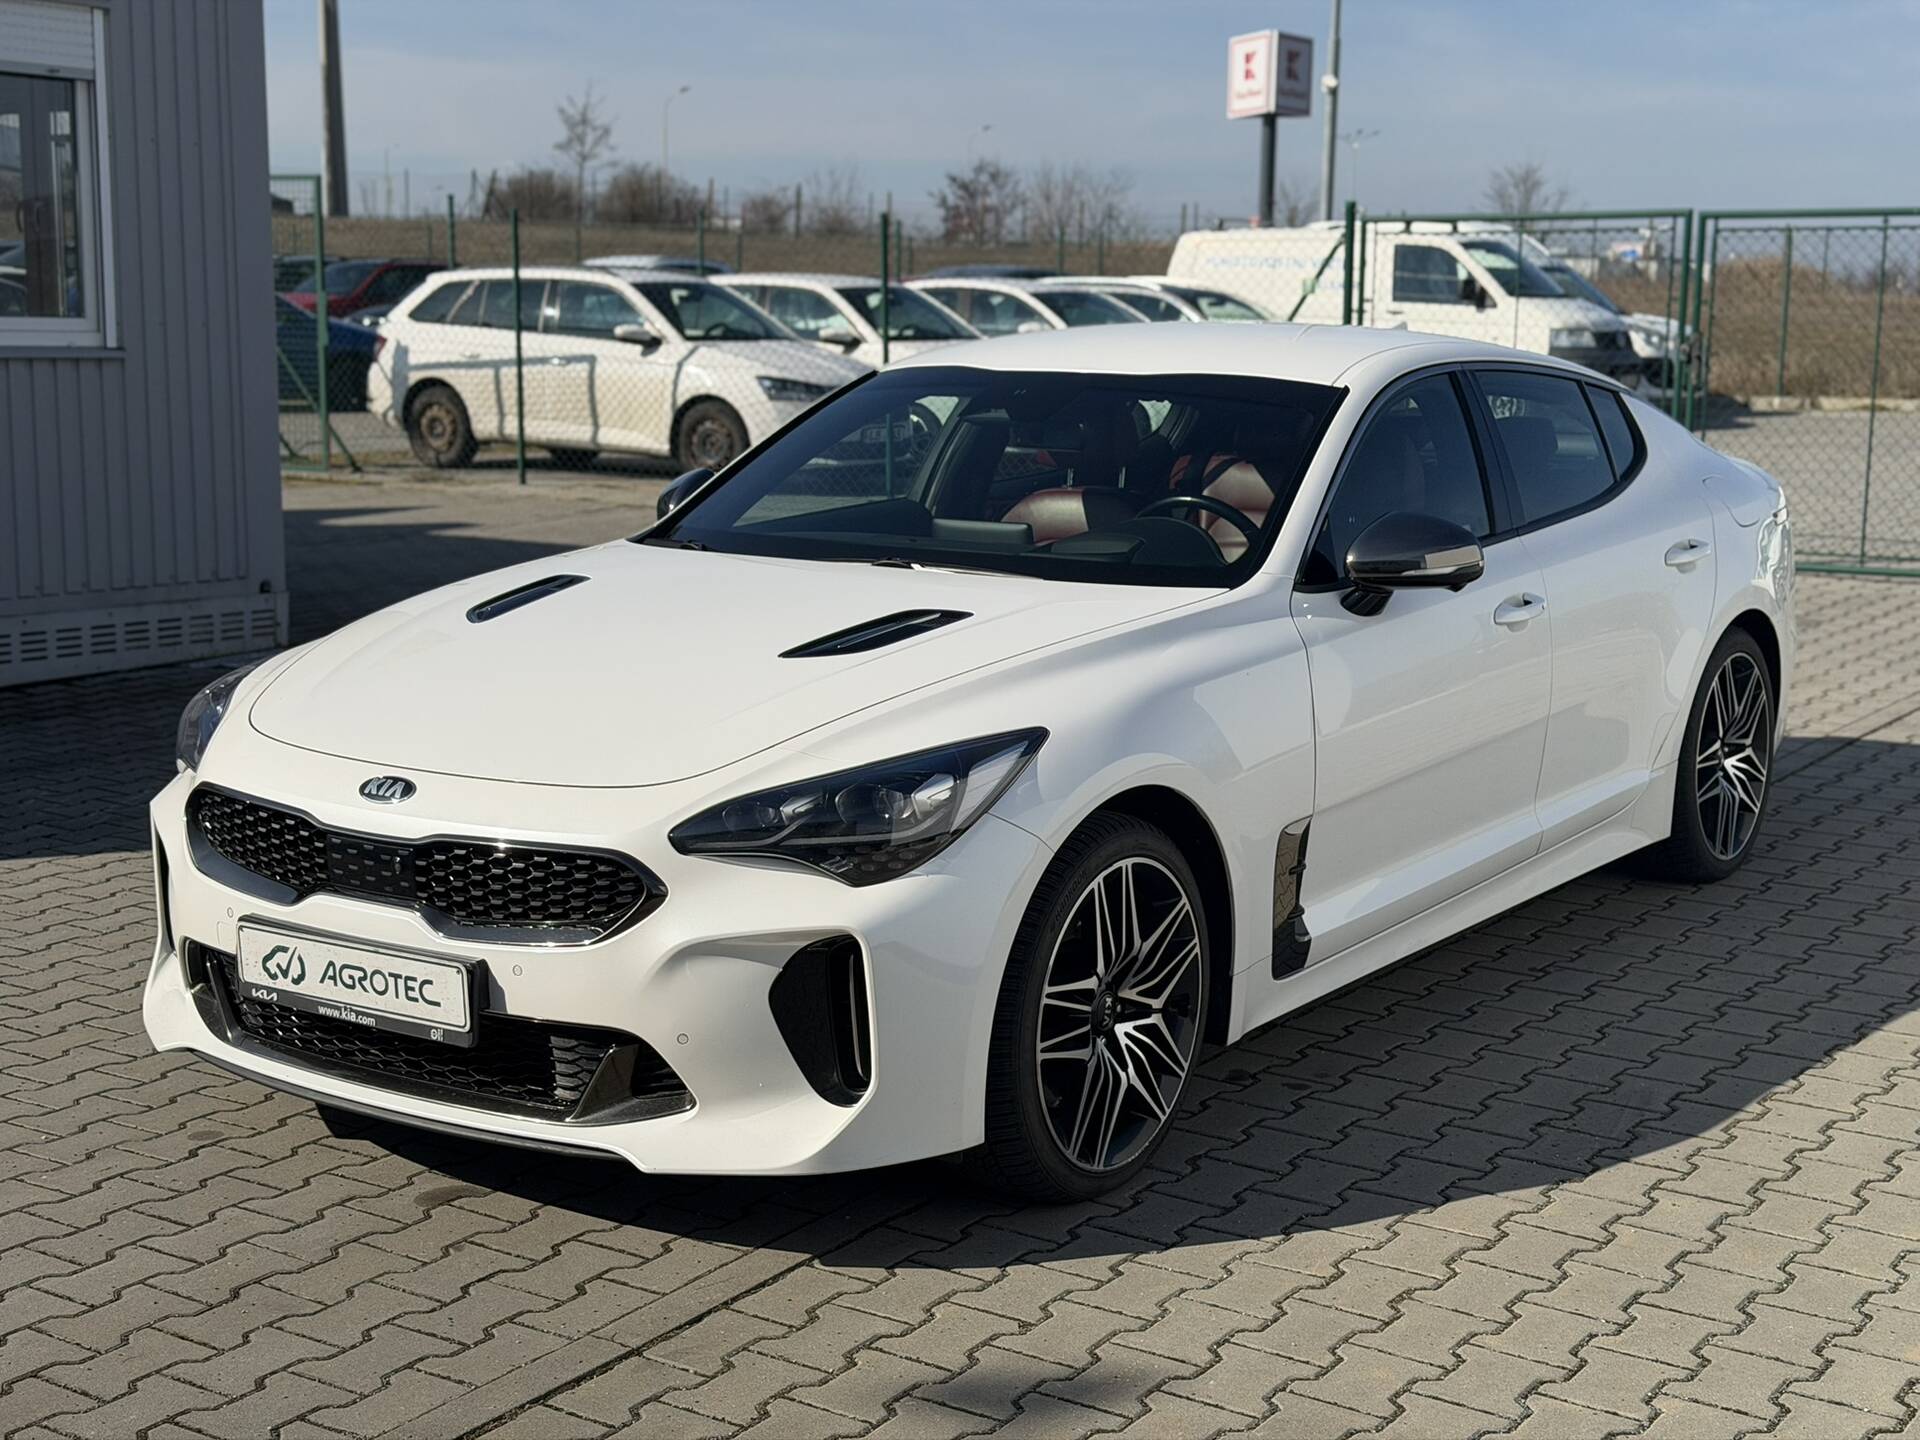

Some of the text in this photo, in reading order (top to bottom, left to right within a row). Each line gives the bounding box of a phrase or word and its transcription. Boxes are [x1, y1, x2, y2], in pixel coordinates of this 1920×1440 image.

[363, 778, 406, 799] KIA
[319, 960, 442, 1008] AGROTEC
[317, 1004, 377, 1028] www.kia.com
